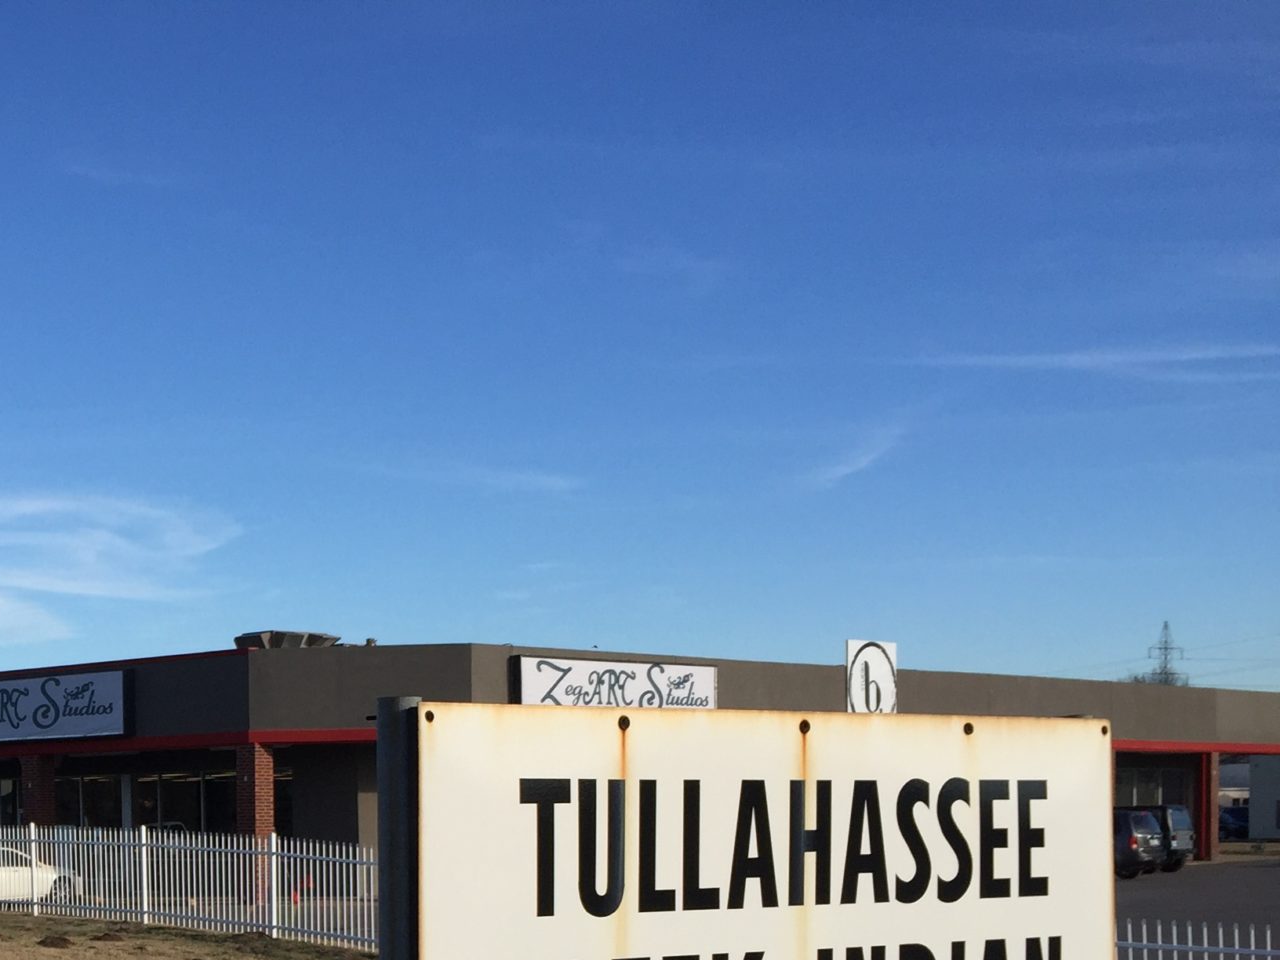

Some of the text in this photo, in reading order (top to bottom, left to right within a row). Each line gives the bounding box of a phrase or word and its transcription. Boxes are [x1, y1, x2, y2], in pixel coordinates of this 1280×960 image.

[32, 677, 114, 729] Studios
[638, 663, 709, 708] Studios
[519, 777, 1049, 918] TULLAHASSEE
